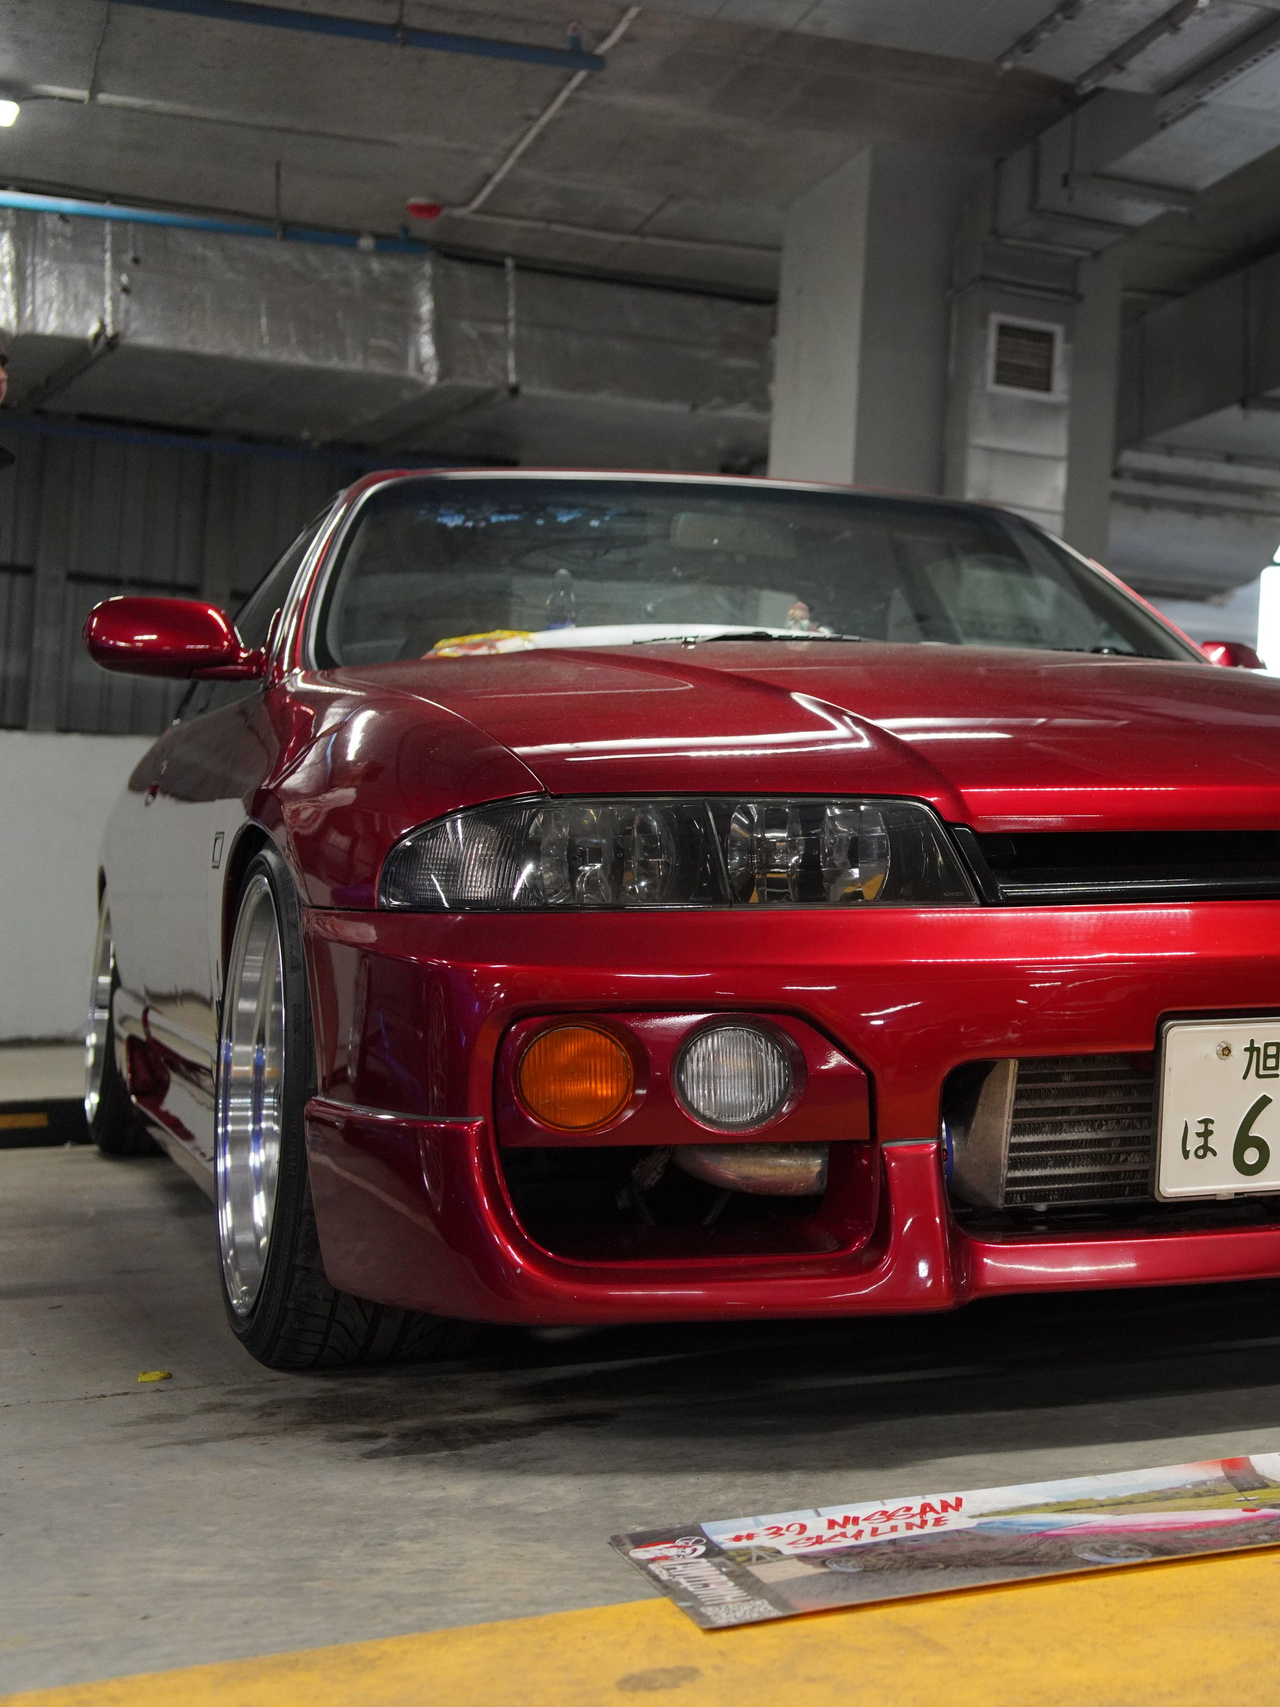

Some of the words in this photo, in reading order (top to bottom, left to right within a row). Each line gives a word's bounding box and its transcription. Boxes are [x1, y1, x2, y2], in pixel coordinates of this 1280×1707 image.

[1181, 1117, 1218, 1160] ほ
[724, 1522, 808, 1543] #39
[827, 1496, 964, 1531] NISSAN
[786, 1516, 950, 1549] SKYLINE
